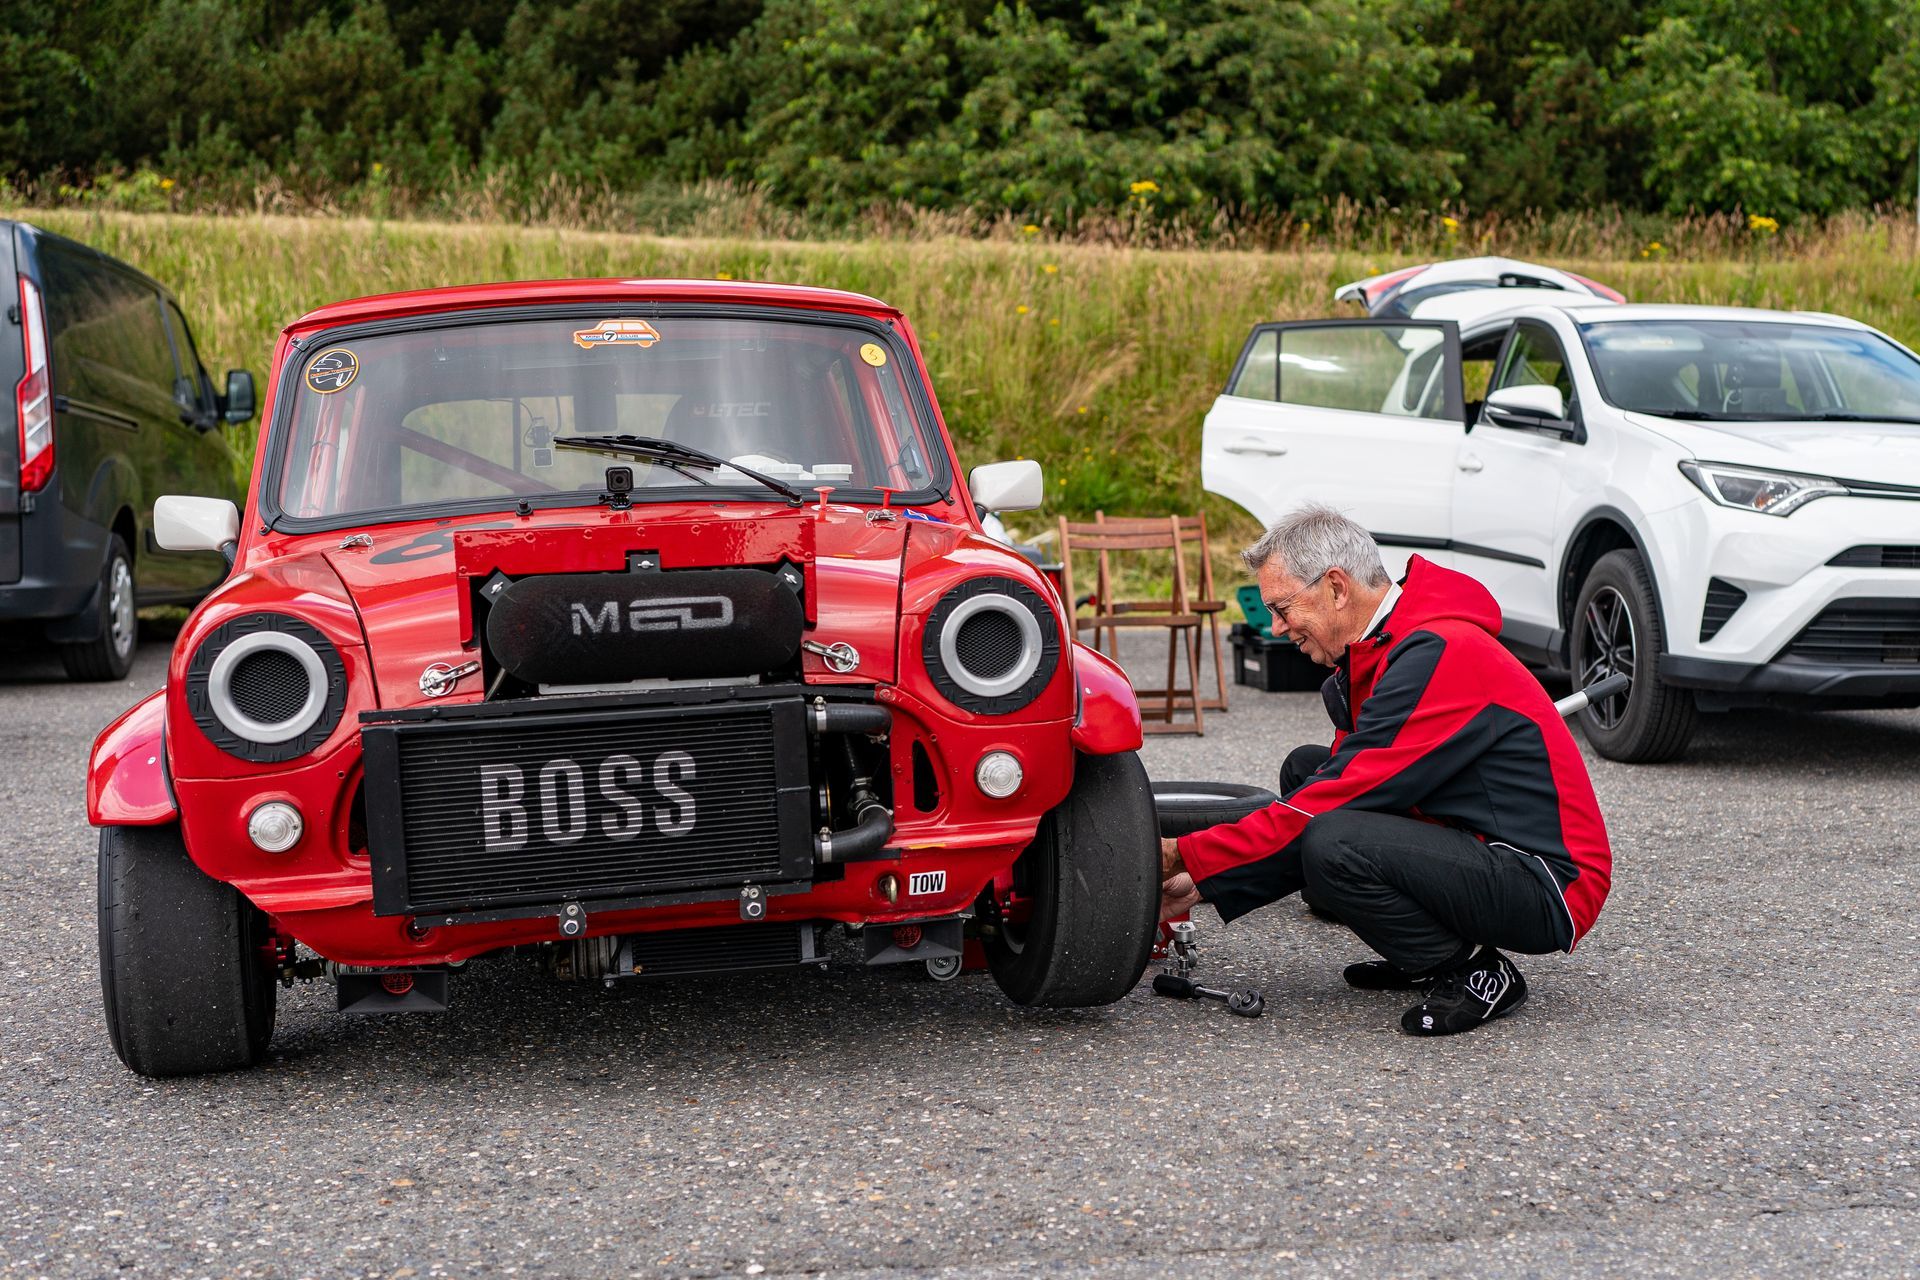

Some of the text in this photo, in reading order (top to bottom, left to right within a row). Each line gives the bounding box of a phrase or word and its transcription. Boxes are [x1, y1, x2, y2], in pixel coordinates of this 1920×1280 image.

[605, 332, 616, 341] 7
[571, 595, 734, 636] MED
[480, 750, 697, 853] BOSS
[911, 872, 945, 894] TOW
